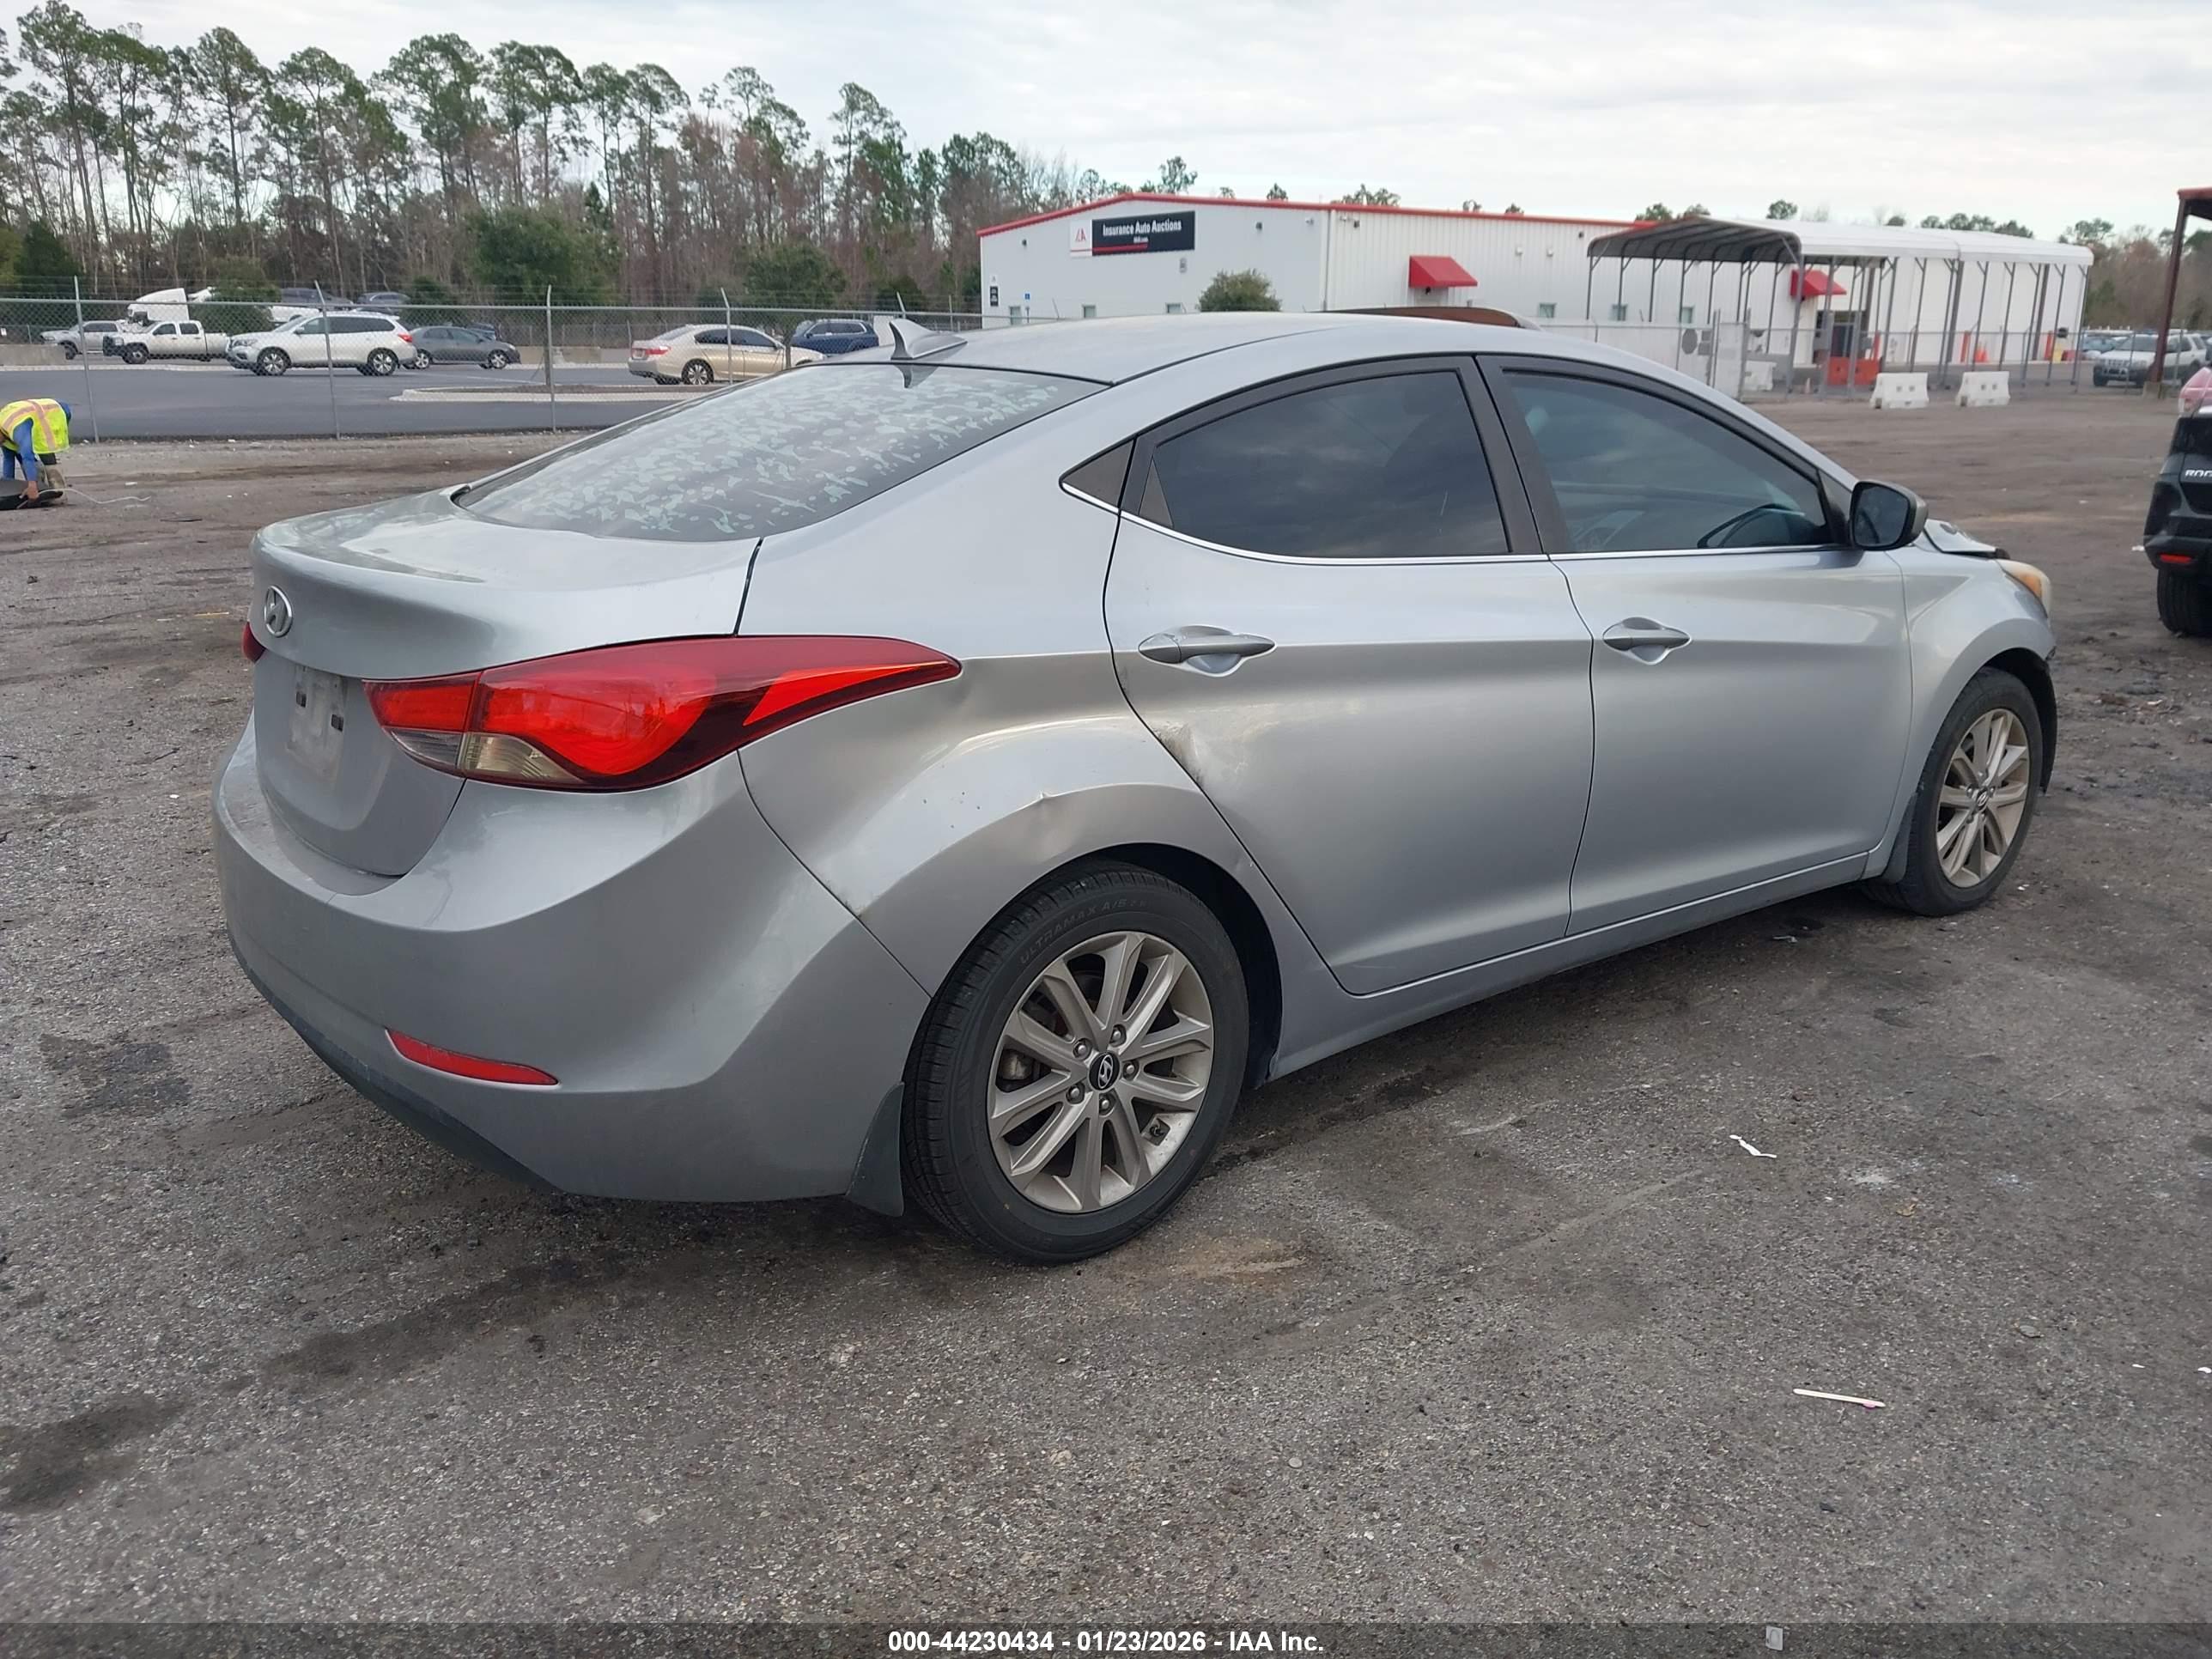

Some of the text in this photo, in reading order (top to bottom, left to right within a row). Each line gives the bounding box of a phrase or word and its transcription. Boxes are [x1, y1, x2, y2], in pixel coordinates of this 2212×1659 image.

[1103, 218, 1182, 236] Insurance Auto Auctions
[1019, 908, 1097, 964] ULTRAMAX
